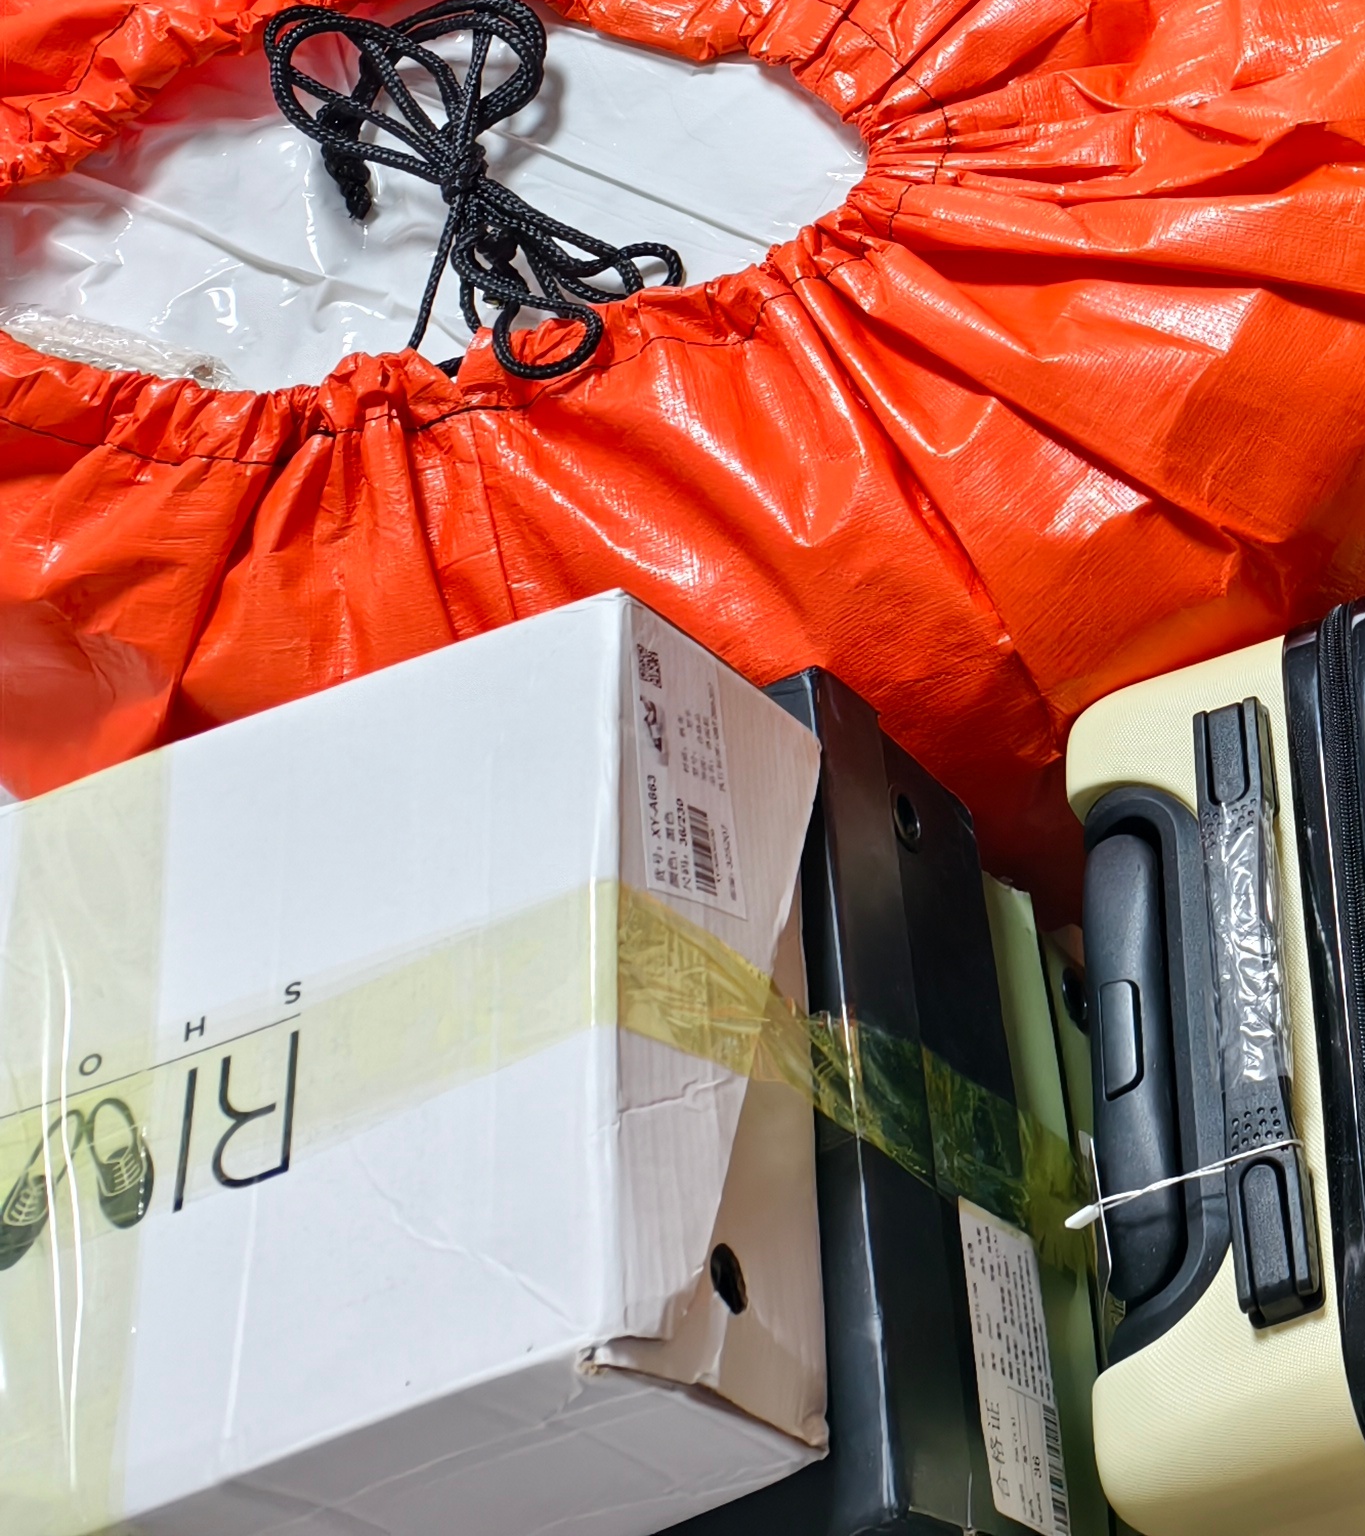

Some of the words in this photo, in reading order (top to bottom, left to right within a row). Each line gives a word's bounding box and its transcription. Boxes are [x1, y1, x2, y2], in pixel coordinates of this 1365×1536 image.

[985, 1398, 1010, 1498] 合格证
[1032, 1455, 1042, 1478] 36
